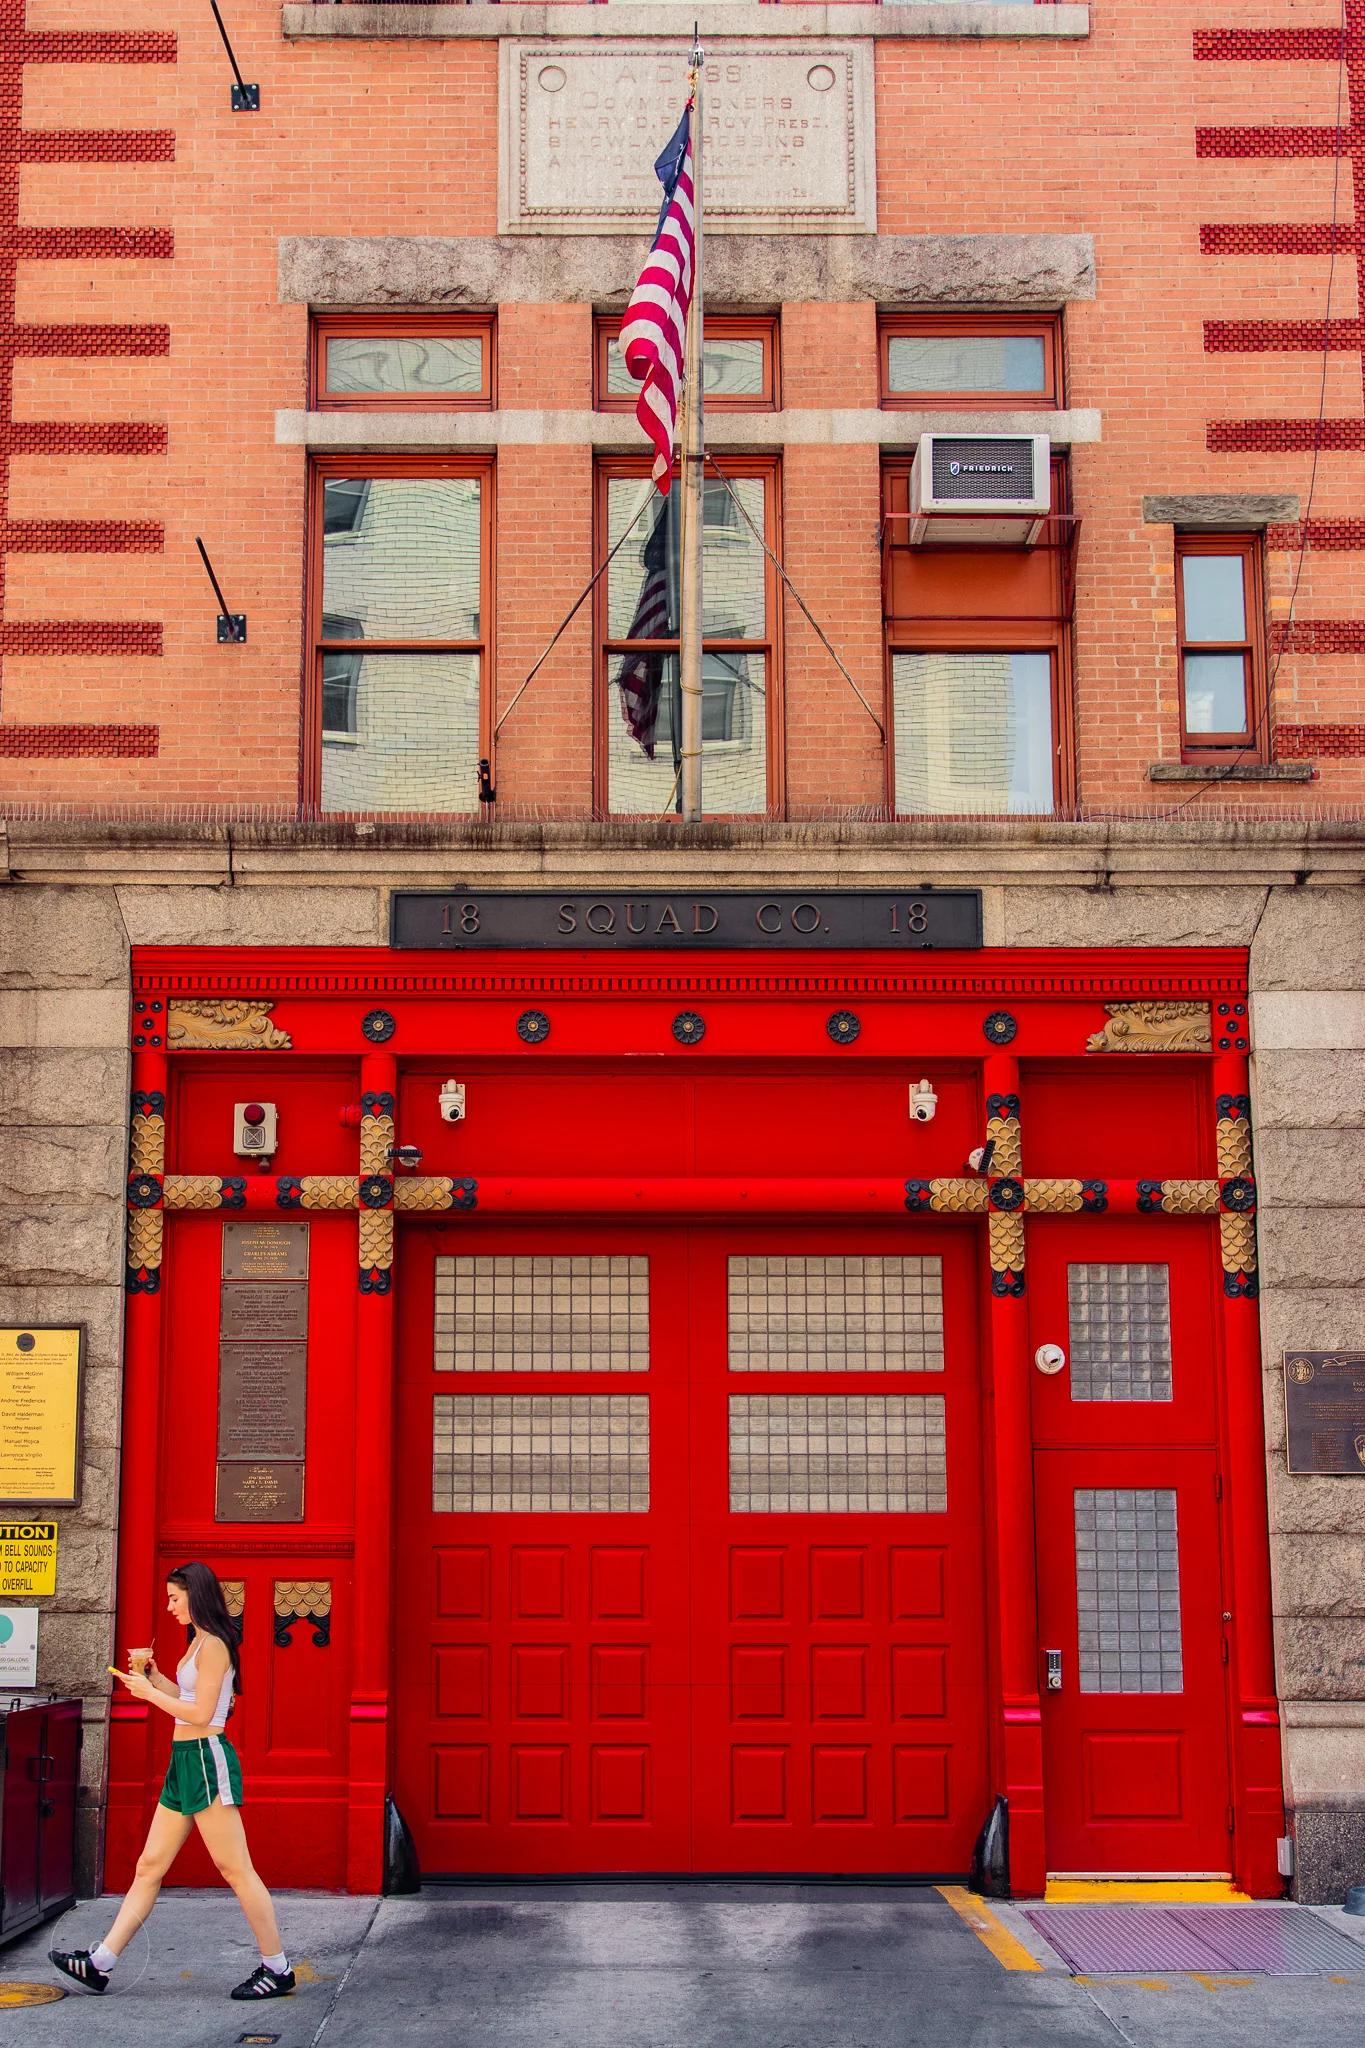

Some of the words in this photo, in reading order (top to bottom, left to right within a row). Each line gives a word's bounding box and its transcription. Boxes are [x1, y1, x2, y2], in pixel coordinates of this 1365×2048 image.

[441, 903, 481, 935] 18
[557, 903, 719, 935] SQUAD
[756, 902, 830, 934] CO.
[889, 902, 928, 934] 18
[5, 1544, 21, 1556] BELL
[4, 1560, 13, 1572] TO
[16, 1560, 48, 1573] CAPACITY
[2, 1578, 33, 1590] OVERFILL
